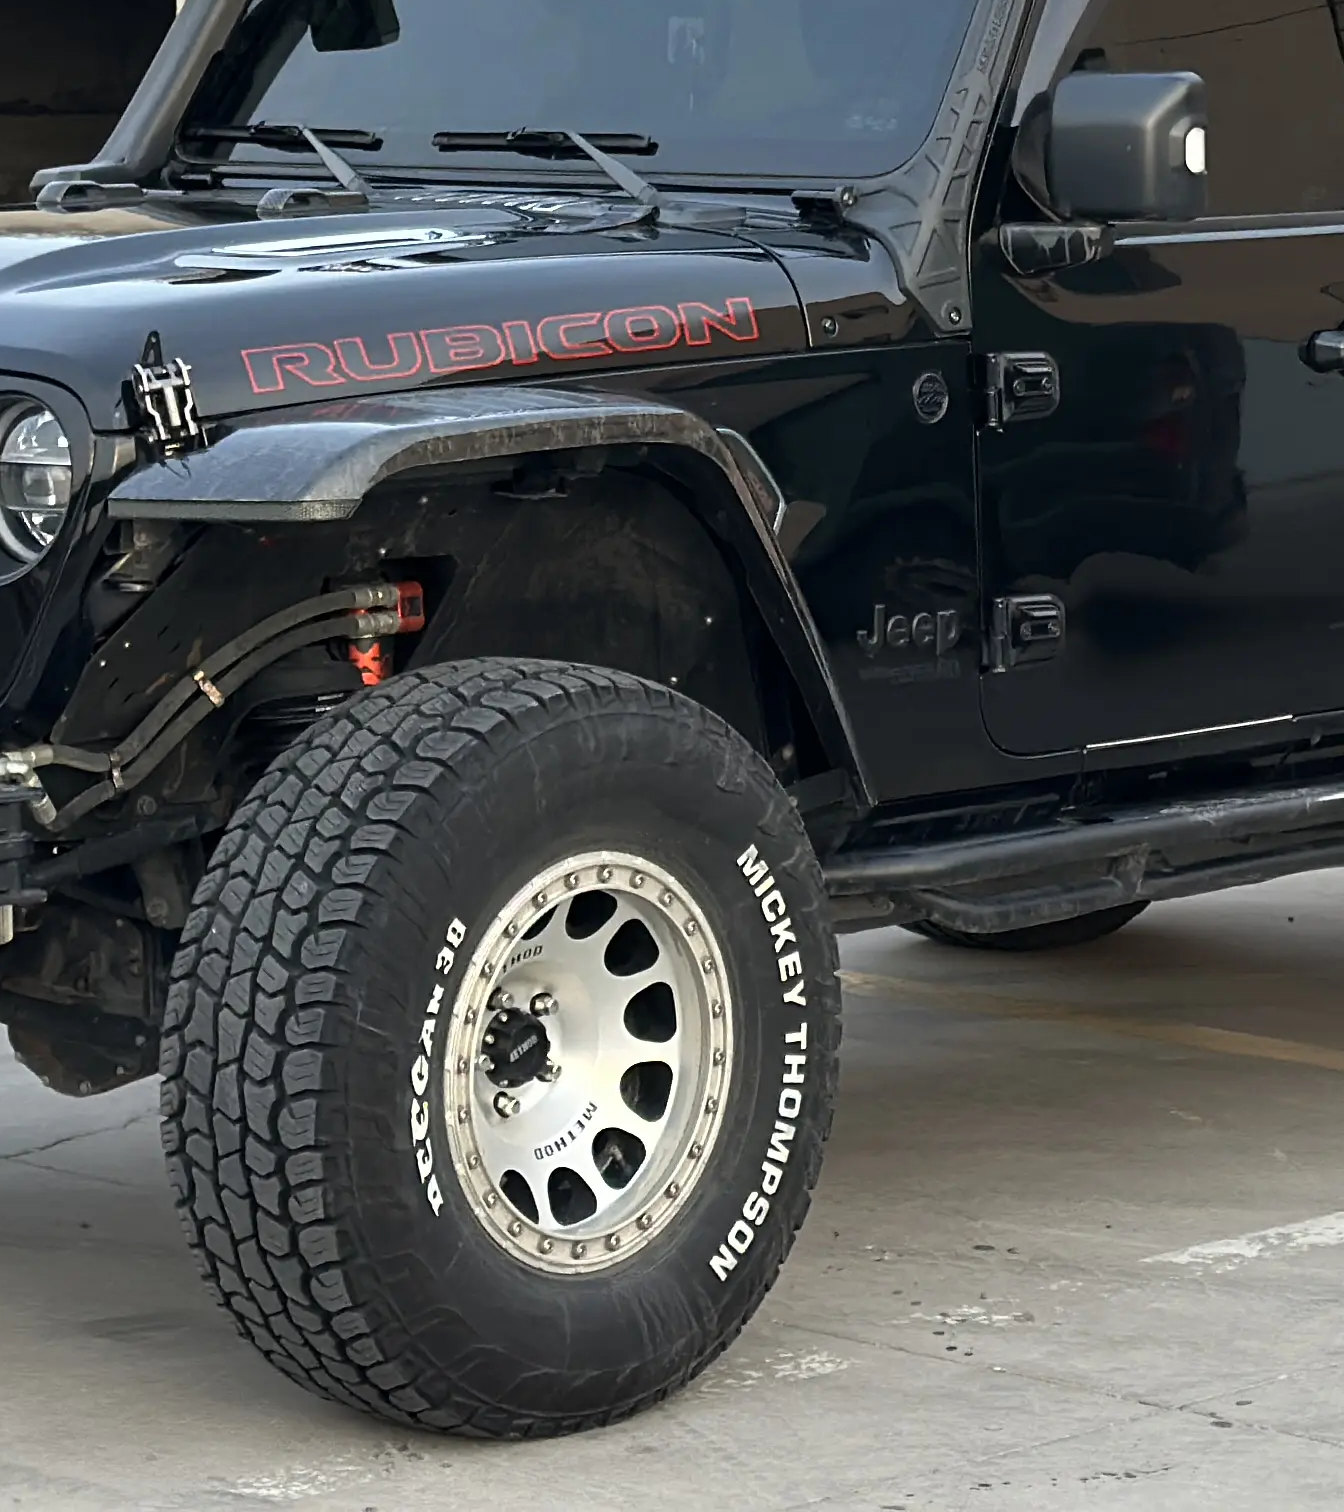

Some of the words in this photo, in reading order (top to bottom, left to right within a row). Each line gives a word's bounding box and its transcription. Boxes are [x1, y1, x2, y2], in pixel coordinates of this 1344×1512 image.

[241, 297, 759, 393] RUBICON
[856, 604, 961, 659] Jeep
[736, 843, 808, 1008] MICKEY
[410, 983, 445, 1217] DEEGAN
[435, 917, 467, 975] 38
[533, 1100, 598, 1161] METHOD
[708, 1021, 808, 1282] THOMPSON
